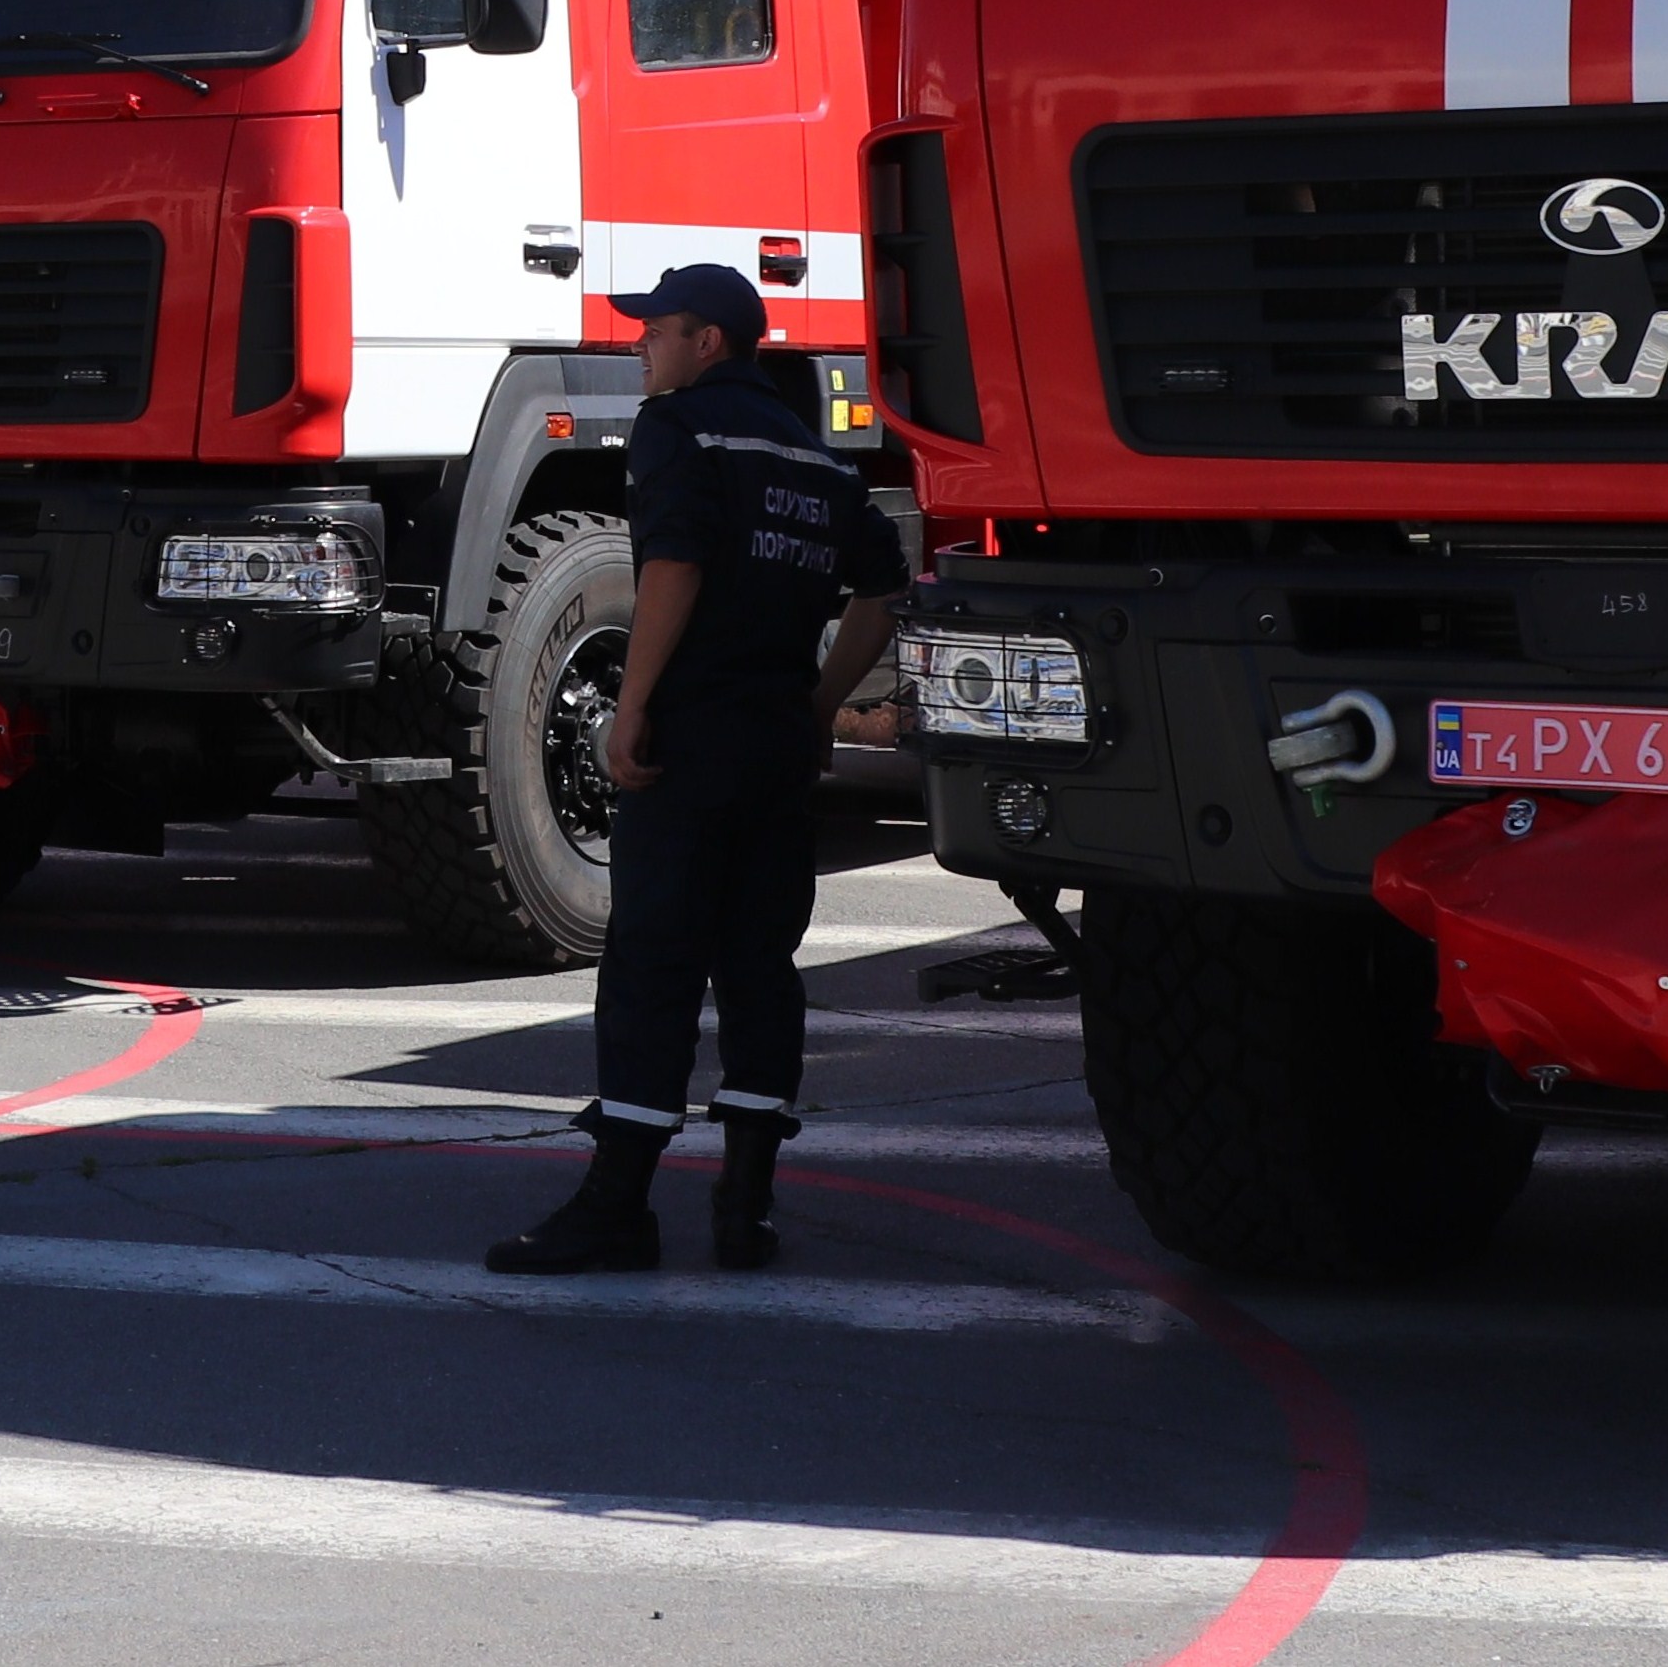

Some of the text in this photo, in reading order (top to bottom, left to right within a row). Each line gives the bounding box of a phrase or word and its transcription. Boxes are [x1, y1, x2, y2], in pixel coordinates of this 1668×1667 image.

[1602, 592, 1648, 615] 458
[1467, 732, 1517, 772] T4
[1534, 717, 1613, 775] PX
[1436, 749, 1461, 769] UA
